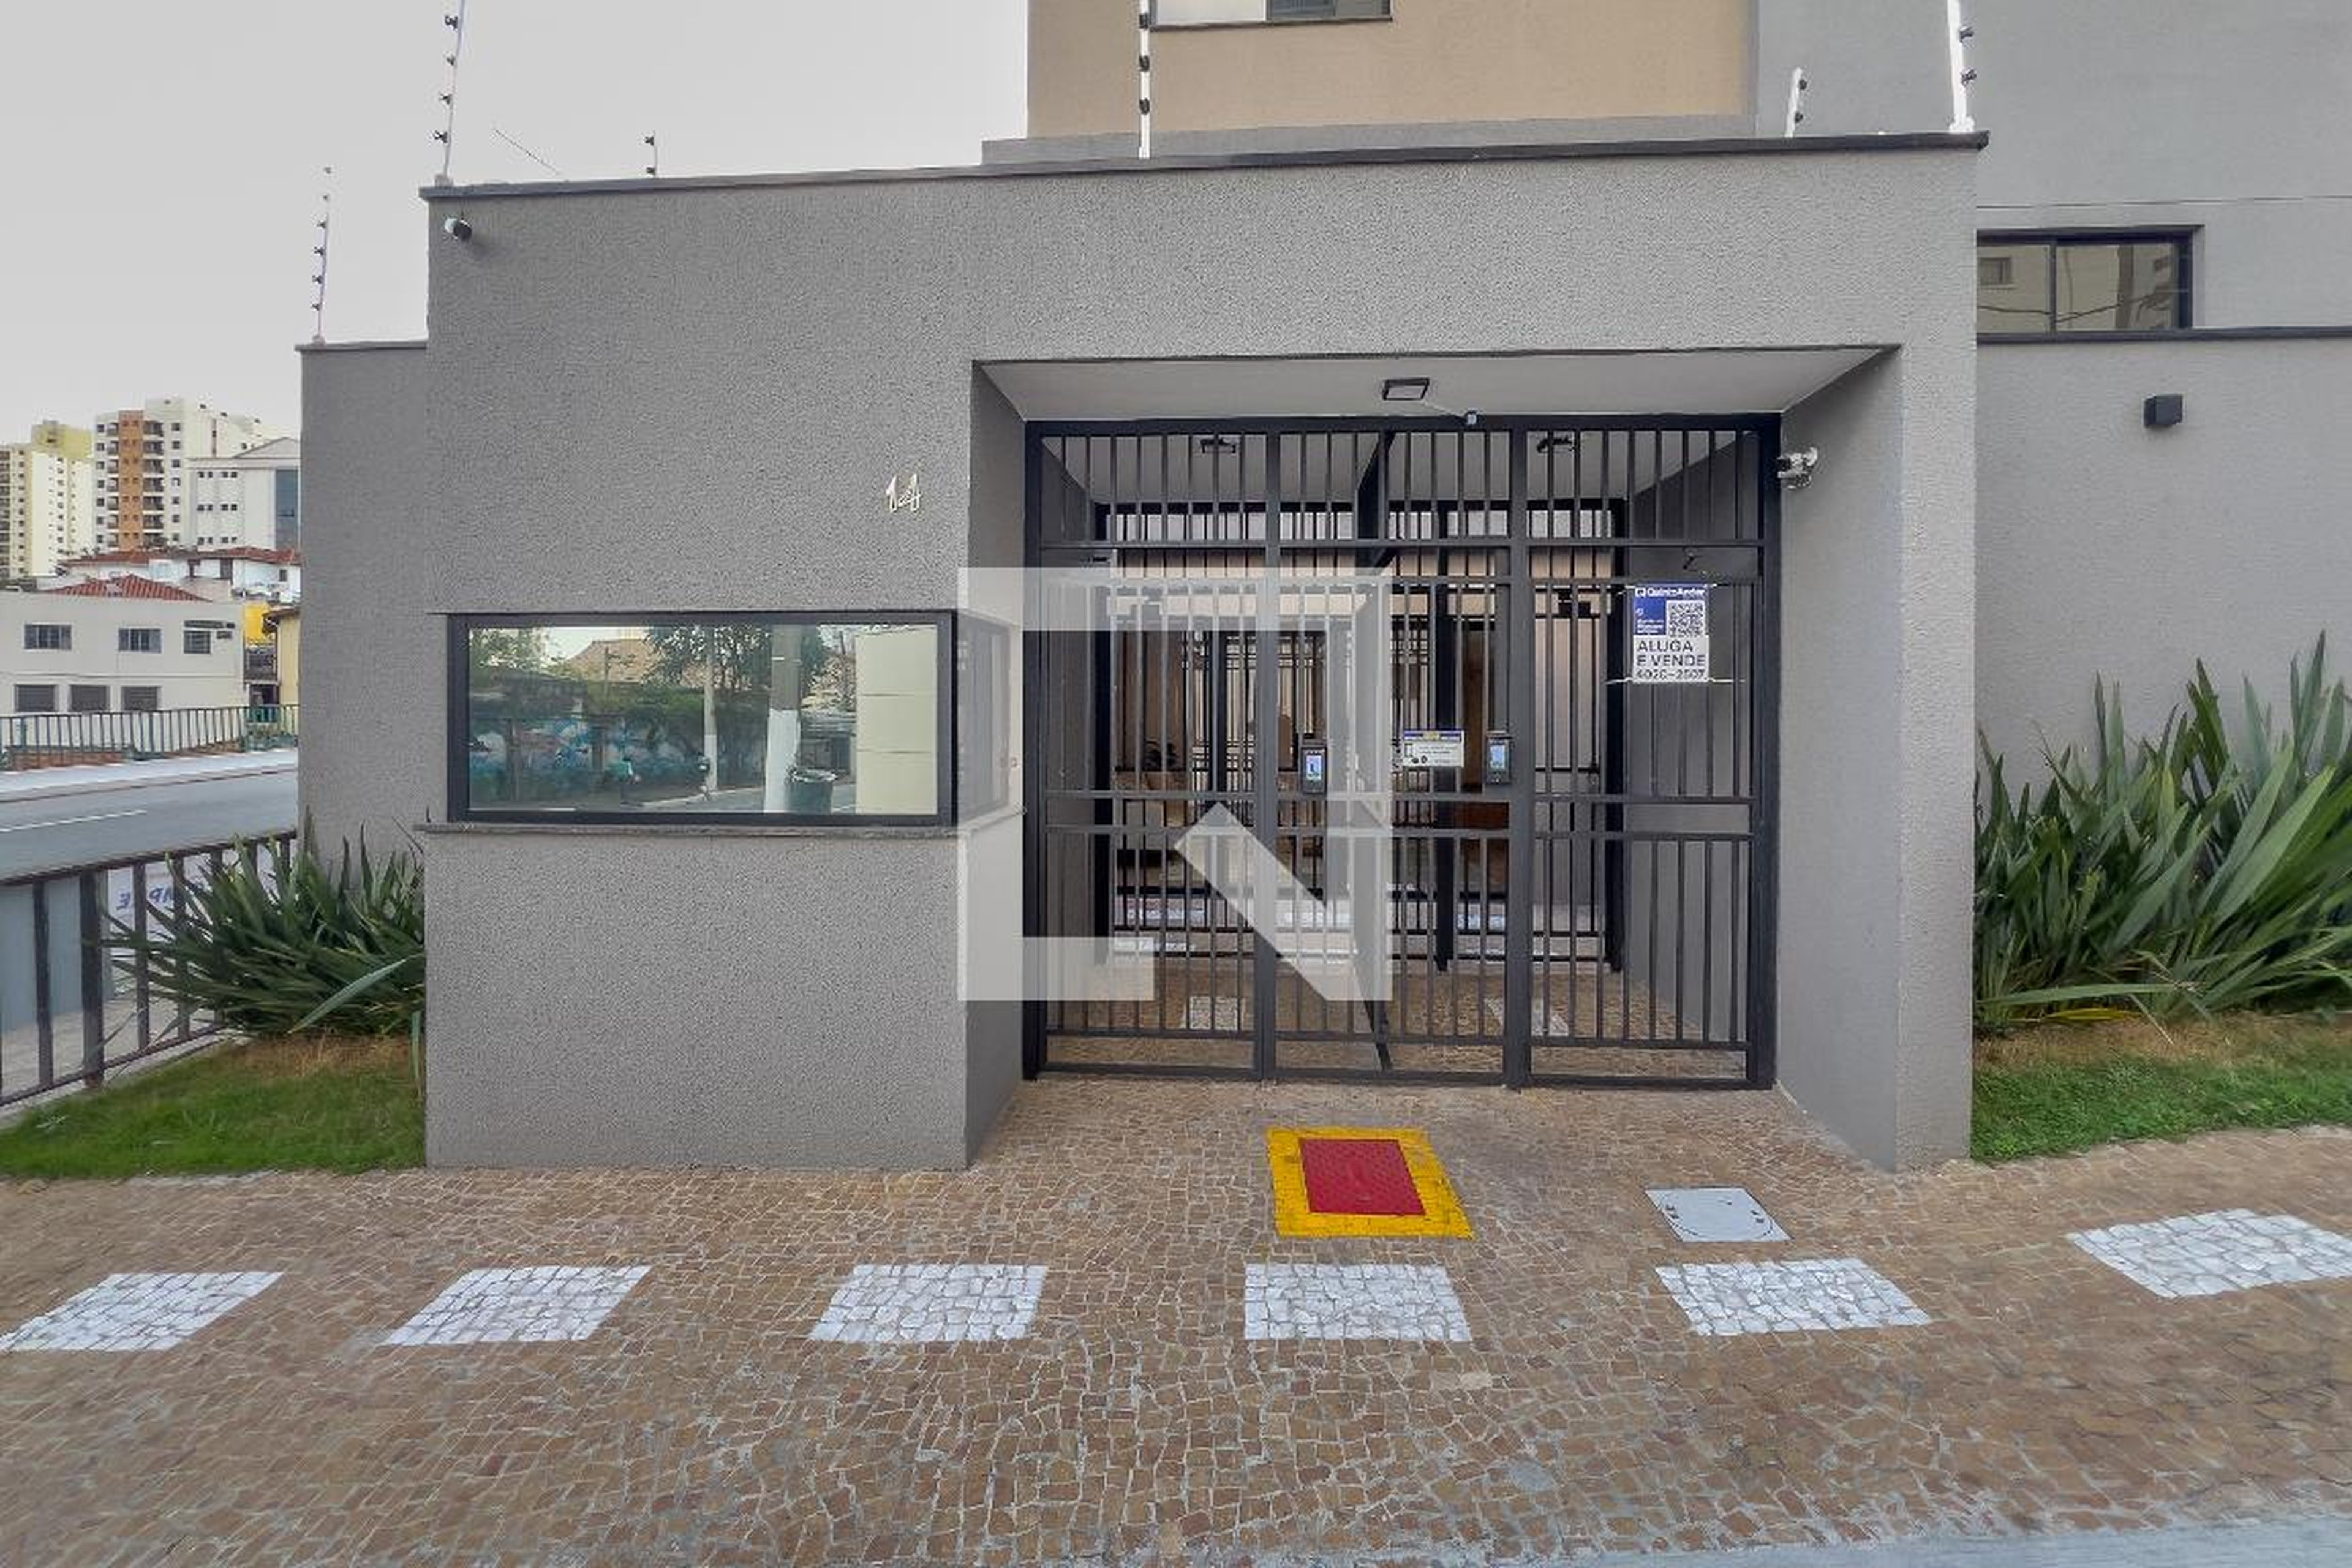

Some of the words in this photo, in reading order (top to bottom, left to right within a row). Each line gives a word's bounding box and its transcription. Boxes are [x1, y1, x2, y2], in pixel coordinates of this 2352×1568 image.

[1637, 640, 1693, 652] ALUGA
[1637, 655, 1646, 666] E
[1651, 655, 1705, 666] VENDE
